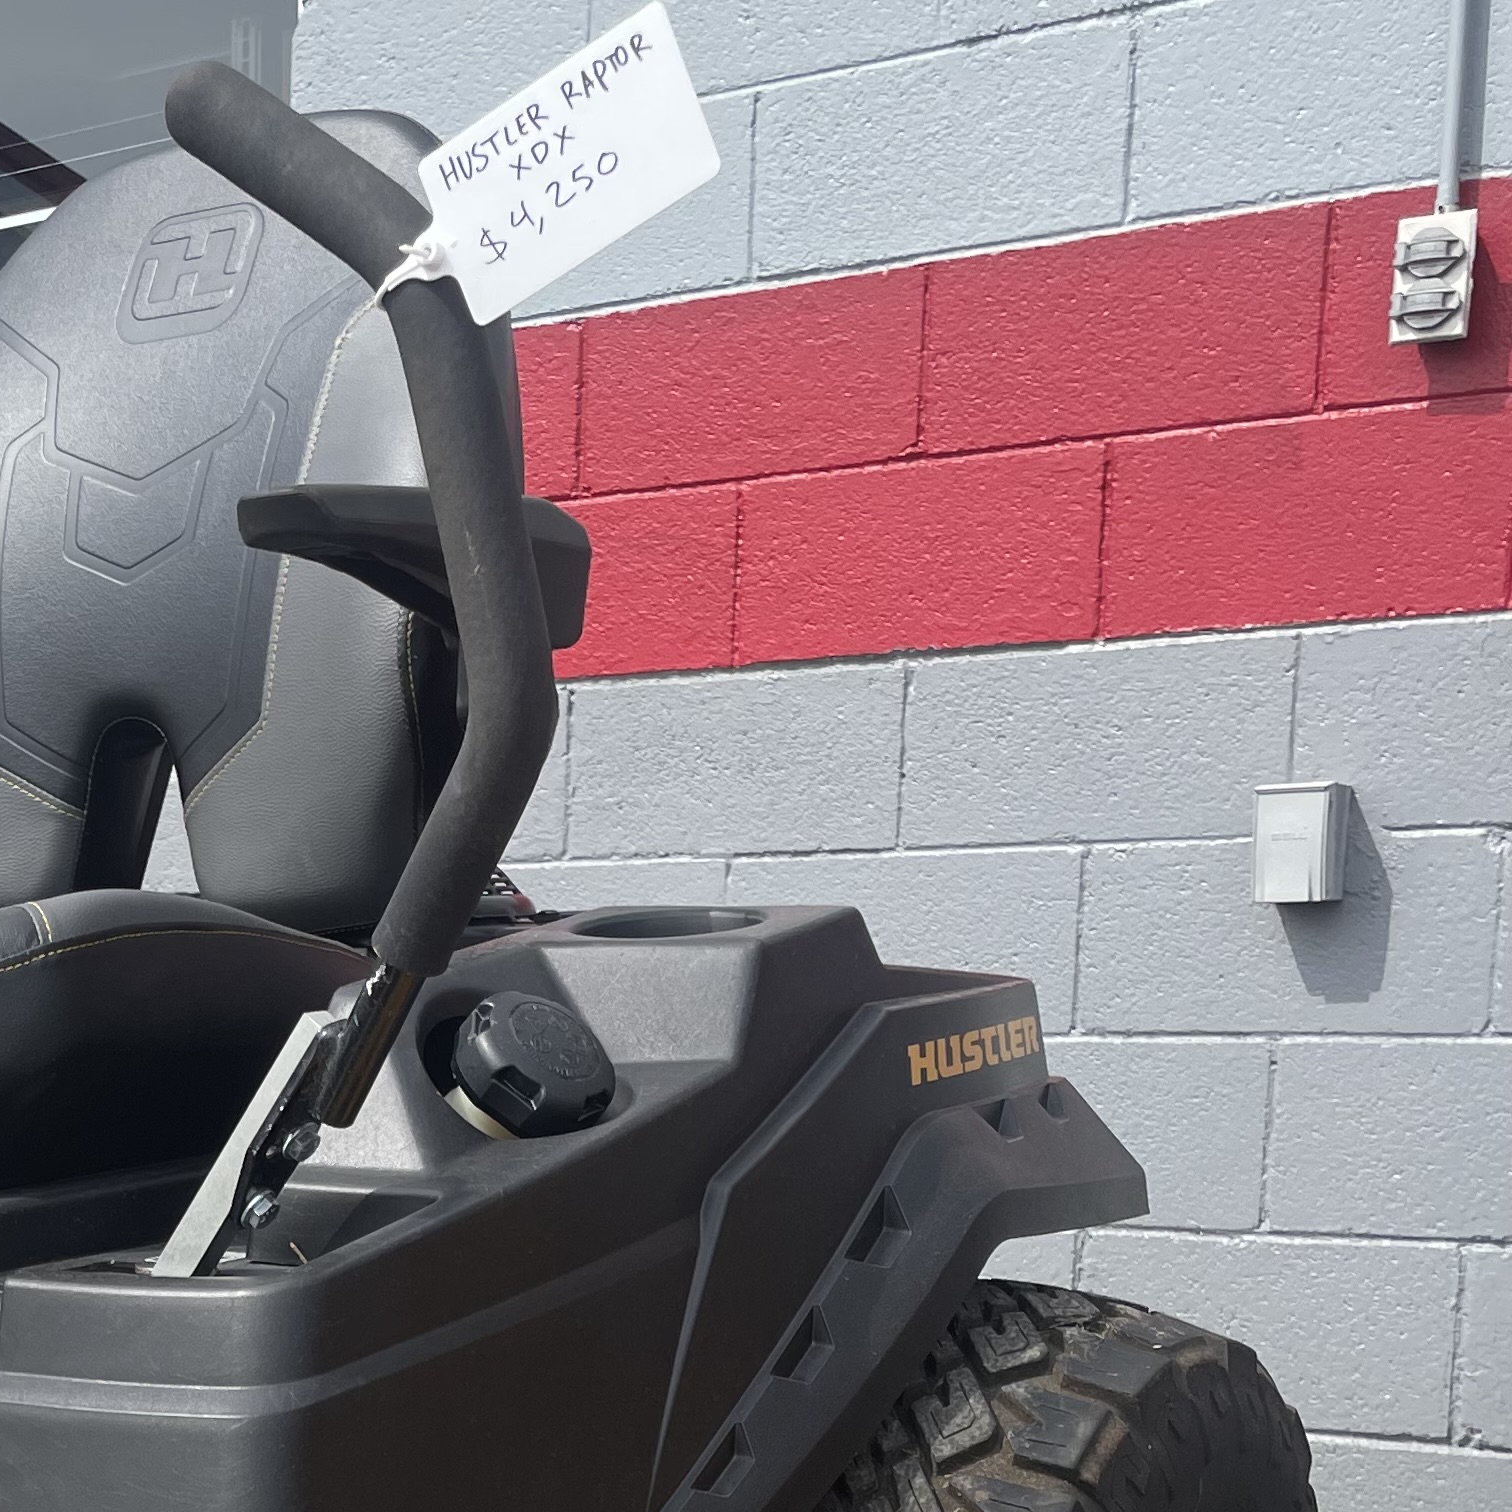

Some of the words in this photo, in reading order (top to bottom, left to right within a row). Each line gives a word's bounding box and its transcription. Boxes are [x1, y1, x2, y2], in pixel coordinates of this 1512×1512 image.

[439, 103, 549, 190] HUSTLER
[560, 34, 653, 109] RAPTOR
[509, 125, 575, 180] XDX
[908, 1016, 1040, 1086] HUSTLER
